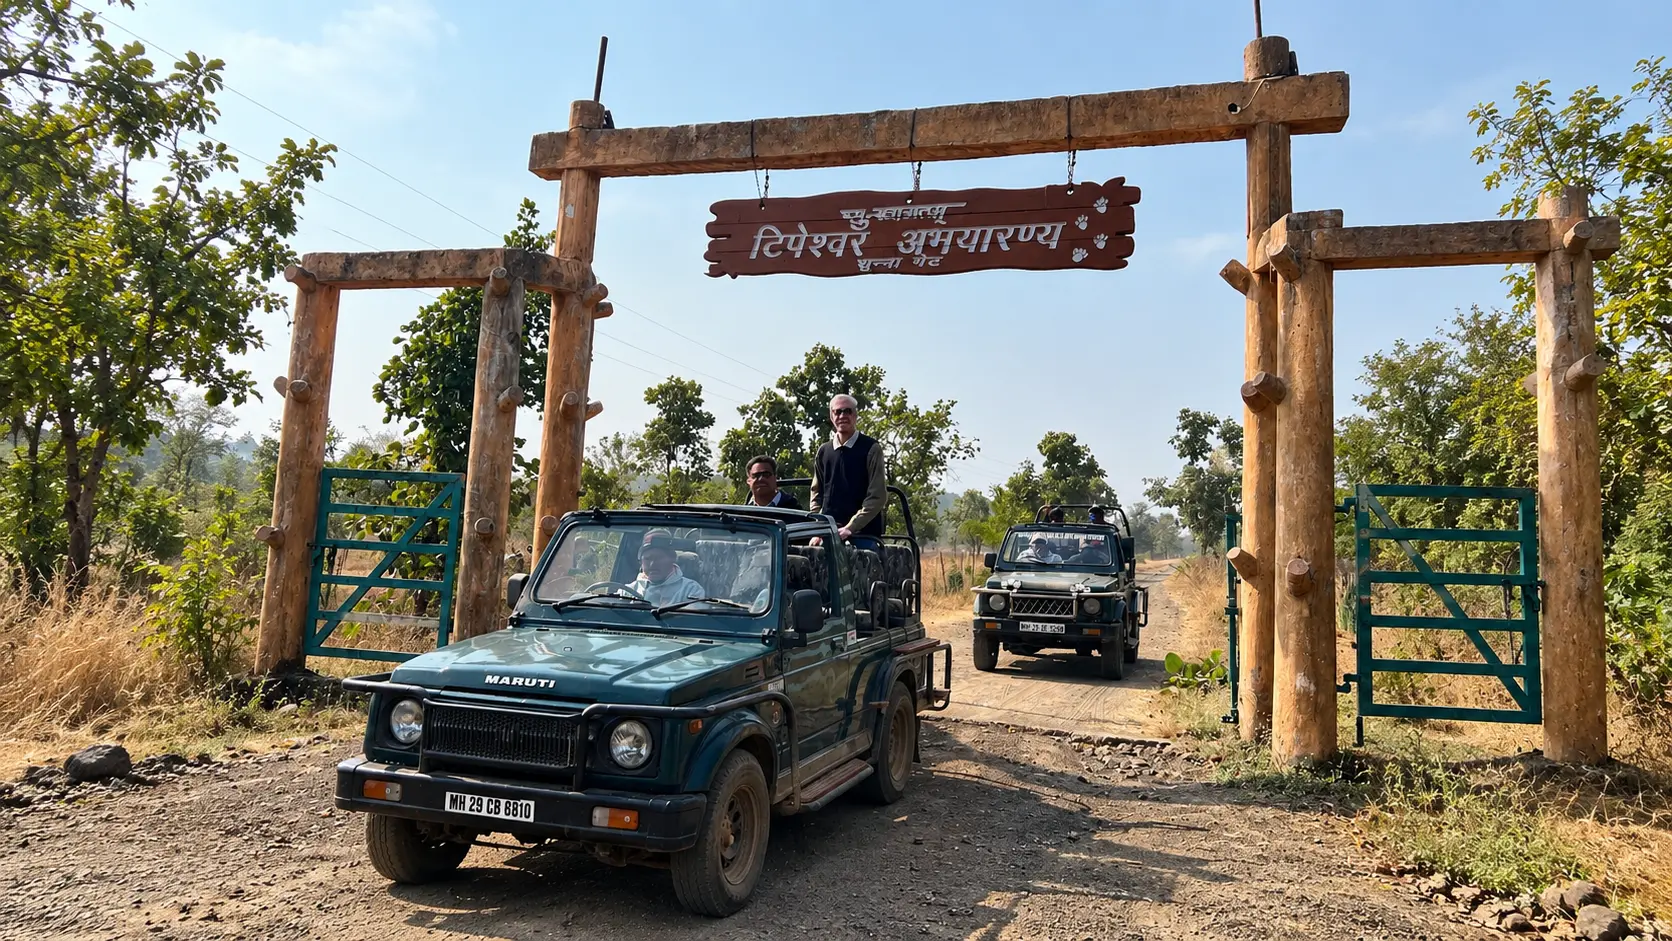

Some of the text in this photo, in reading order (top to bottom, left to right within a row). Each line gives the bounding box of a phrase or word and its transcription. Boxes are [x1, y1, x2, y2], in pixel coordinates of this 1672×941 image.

[749, 221, 1067, 259] टिपेश्वर अभयारण्य
[484, 674, 556, 689] MARUTI
[449, 794, 466, 811] MH
[469, 796, 483, 813] 29
[486, 798, 501, 815] CB
